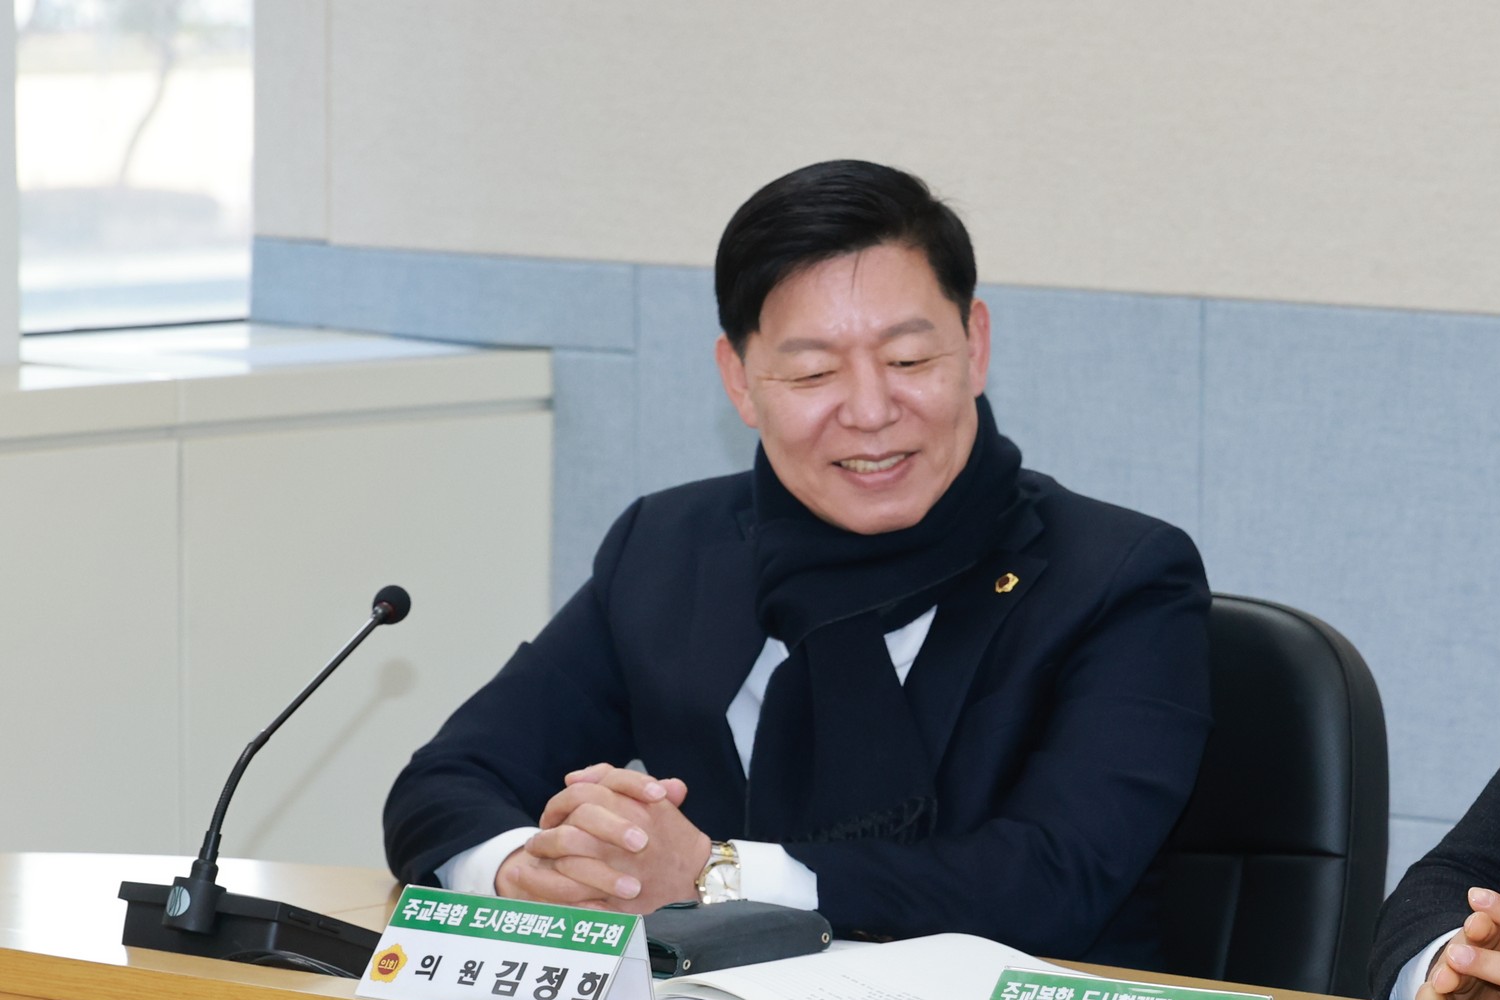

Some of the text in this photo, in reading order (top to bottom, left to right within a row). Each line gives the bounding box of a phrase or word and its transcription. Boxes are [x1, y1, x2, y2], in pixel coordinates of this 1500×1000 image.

[402, 898, 626, 947] 주교복합 도시형캠퍼스 연구회
[378, 959, 398, 970] 의회
